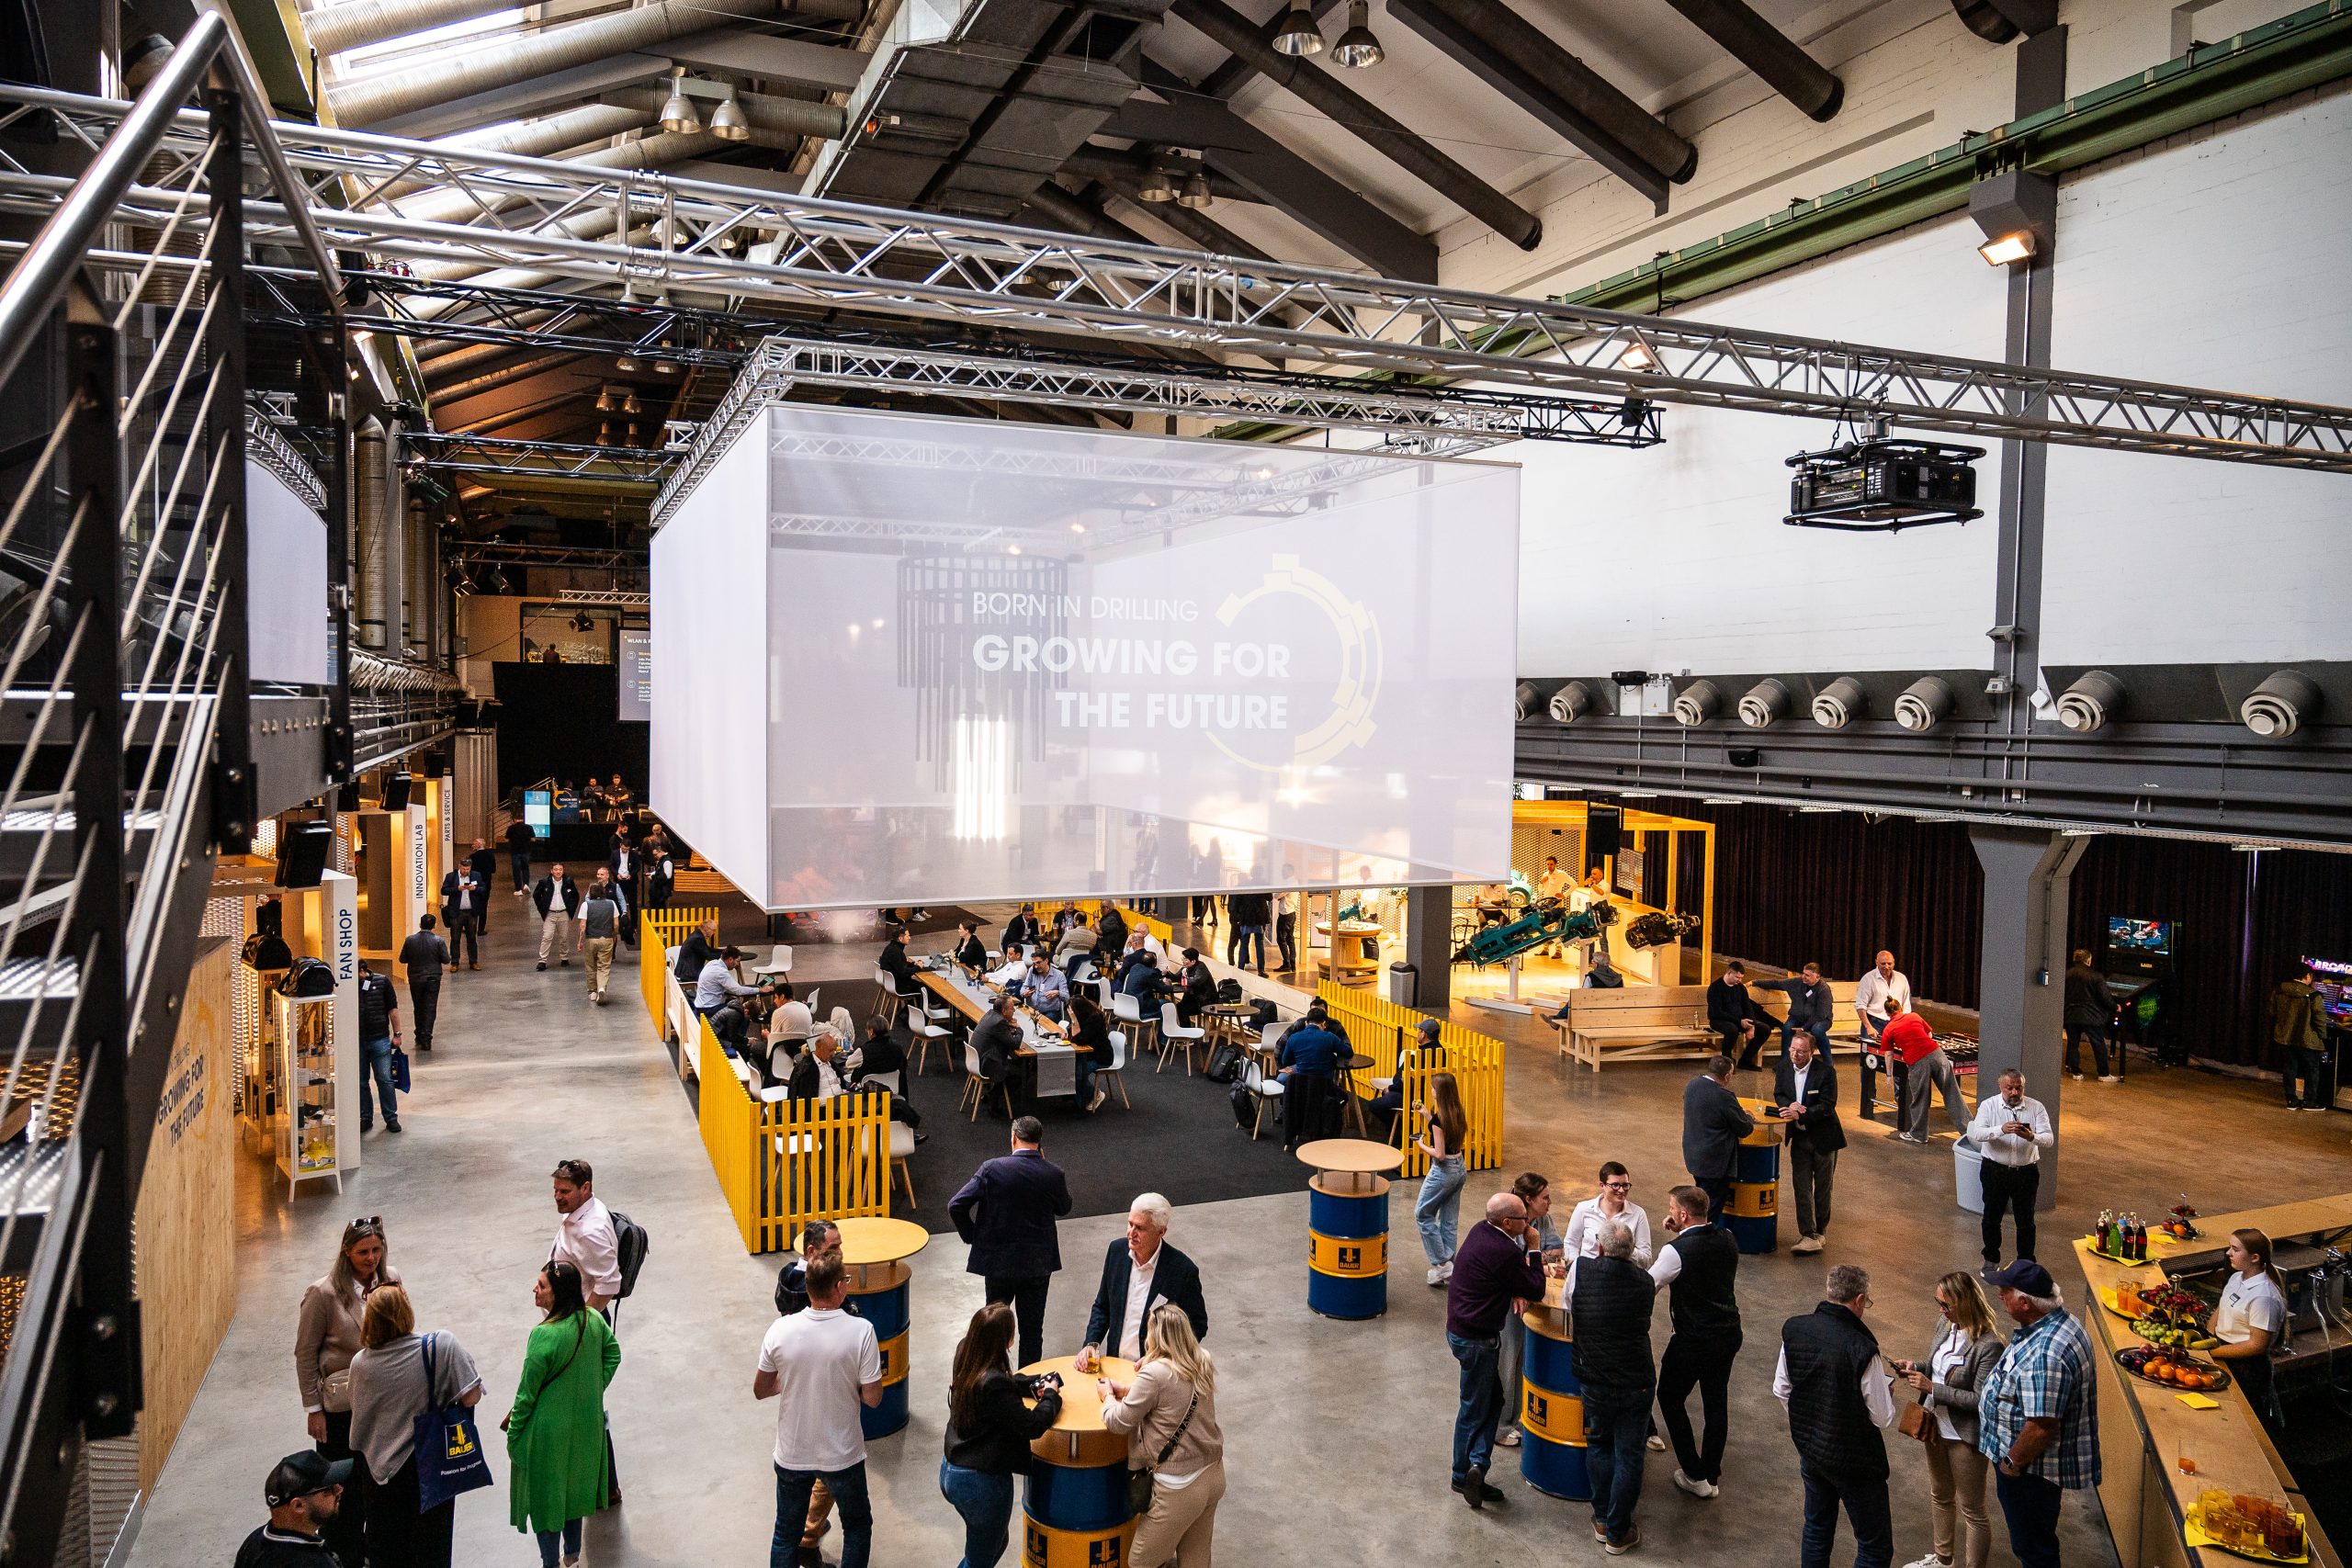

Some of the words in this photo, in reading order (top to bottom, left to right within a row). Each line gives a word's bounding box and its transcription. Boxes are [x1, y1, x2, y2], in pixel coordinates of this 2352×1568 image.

[973, 592, 1046, 617] BORN
[1057, 594, 1081, 618] IN
[1091, 596, 1198, 622] DRILLING
[972, 634, 1198, 676] GROWING
[1213, 642, 1290, 678] FOR
[1056, 691, 1130, 728] THE
[1147, 693, 1287, 729] FUTURE
[415, 824, 424, 840] LAB
[339, 908, 352, 948] SHOP
[340, 951, 353, 980] FAN
[2314, 961, 2352, 974] ARCAD
[157, 1070, 189, 1125] GROWING
[191, 1054, 203, 1086] FOR
[171, 1114, 182, 1148] THE
[183, 1087, 204, 1132] FUTURE
